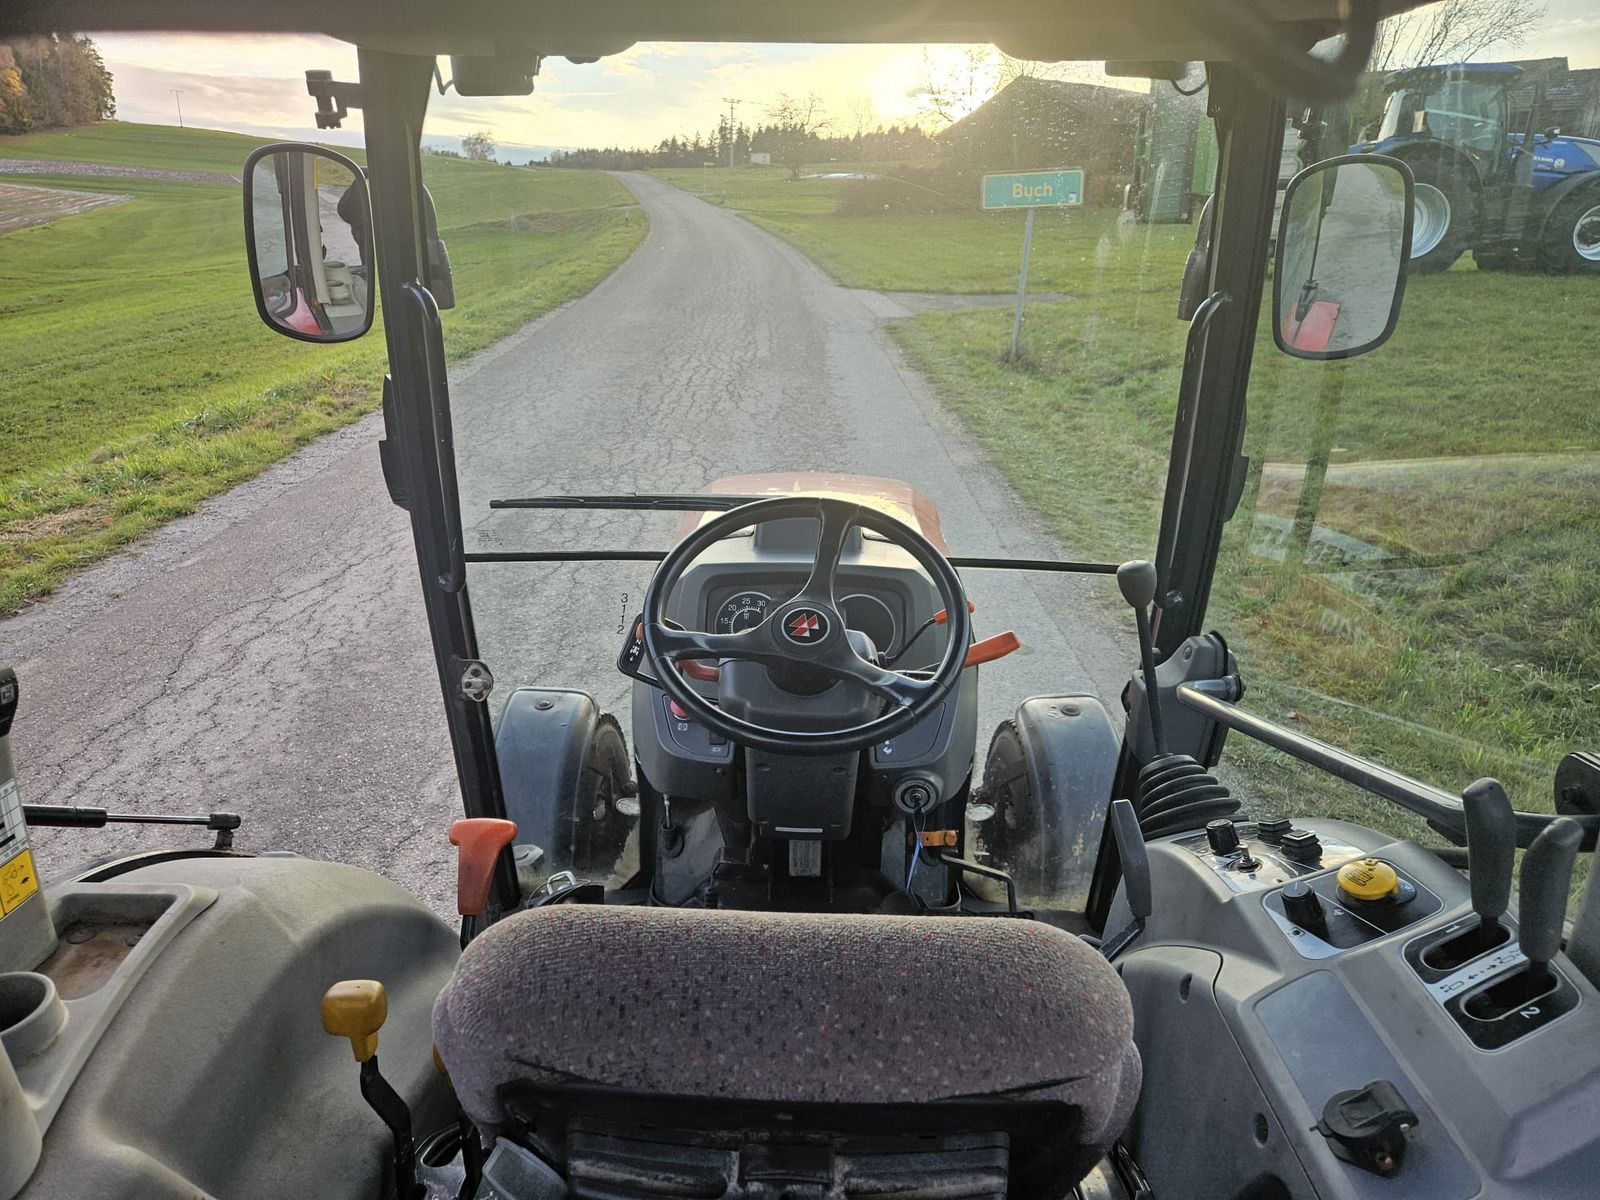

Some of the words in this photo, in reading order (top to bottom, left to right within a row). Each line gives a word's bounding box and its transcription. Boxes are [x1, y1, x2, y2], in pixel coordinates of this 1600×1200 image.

[1012, 182, 1053, 198] Buch
[742, 597, 751, 605] 25
[720, 617, 729, 625] 15
[1519, 1007, 1540, 1019] 2
